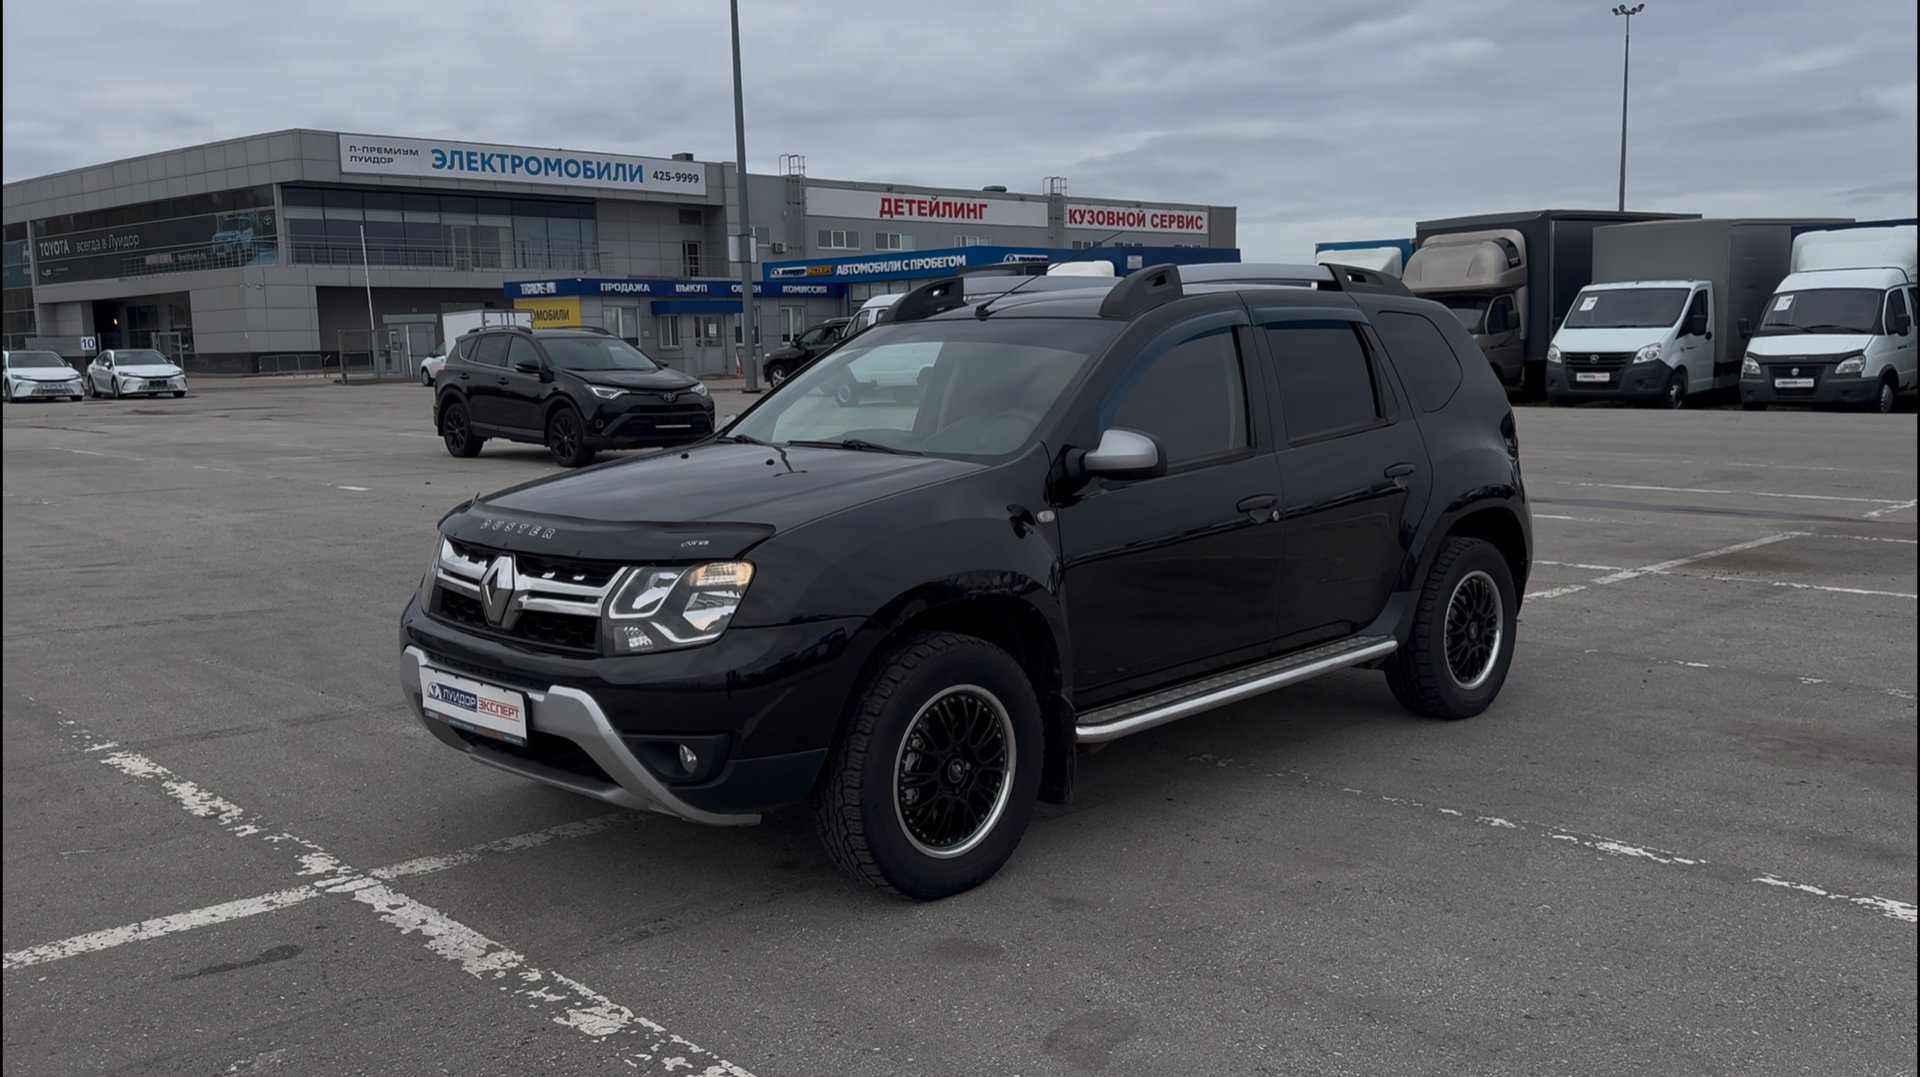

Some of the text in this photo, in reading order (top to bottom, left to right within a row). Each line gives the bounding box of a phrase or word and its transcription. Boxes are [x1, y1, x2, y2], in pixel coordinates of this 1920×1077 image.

[350, 155, 394, 165] ЛУИДОР
[431, 149, 644, 183] ЭЛЕКТРОМОБИЛИ
[652, 170, 699, 184] 425-9999
[879, 196, 988, 220] ДЕТЕЙЛИНГ
[1068, 207, 1204, 230] КУЗОВНОЙ СЕРВИС
[39, 239, 70, 257] TOYOTA
[76, 240, 101, 252] всегда
[108, 234, 140, 252] Луидор
[836, 260, 902, 275] АВТОМОБИЛИ
[902, 260, 910, 270] С
[911, 255, 967, 270] ПРОБЕГОМ
[600, 283, 651, 293] ПРОДАЖА
[675, 284, 708, 293] ВЫКУП
[731, 285, 762, 293] ОБЕН
[782, 285, 828, 294] КОМИССИЯ
[82, 338, 95, 348] 10
[480, 519, 555, 539] DUSTER
[443, 688, 520, 719] ЛУИДОР ЭКСПЕРТ
